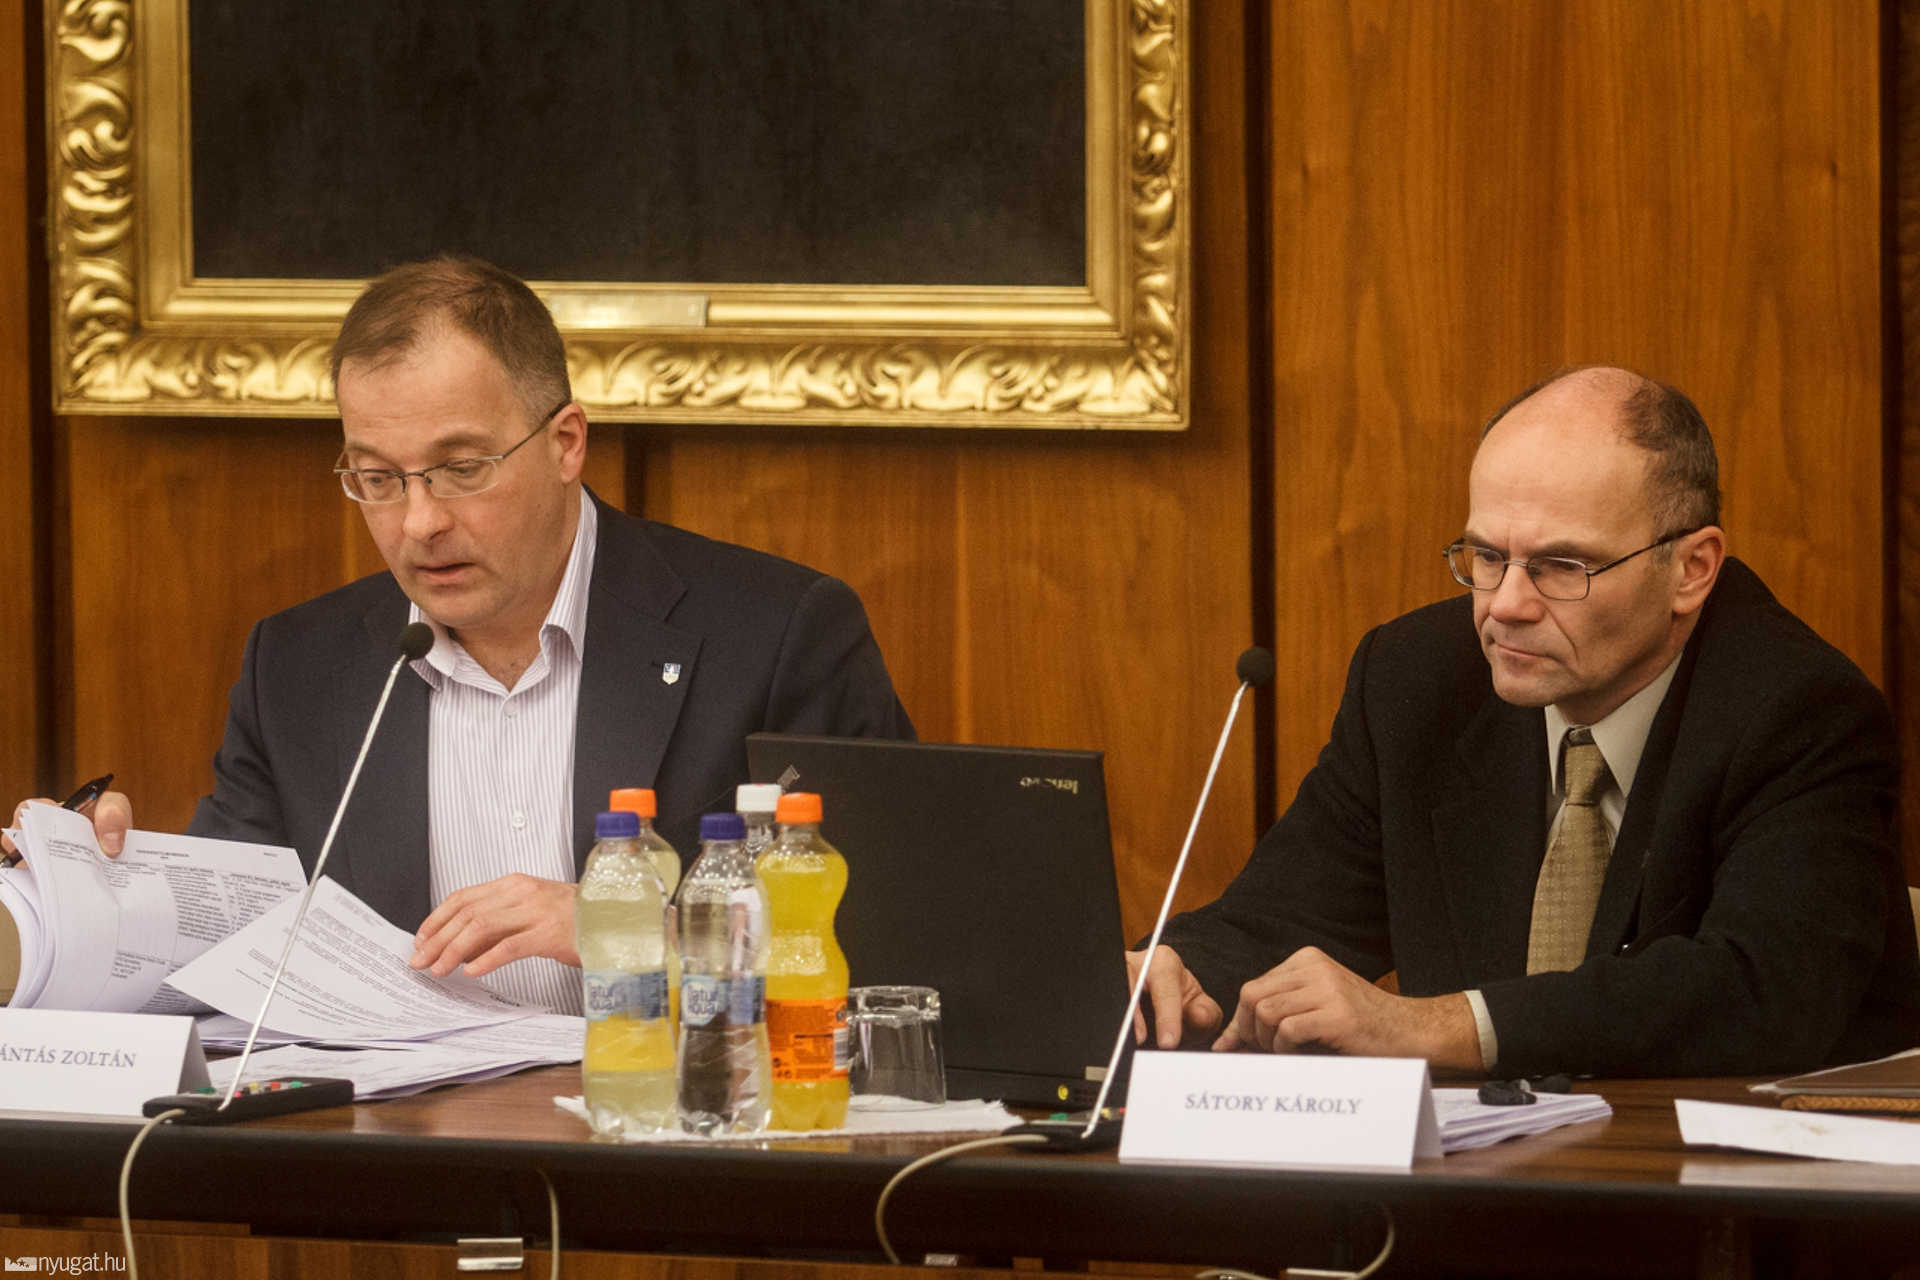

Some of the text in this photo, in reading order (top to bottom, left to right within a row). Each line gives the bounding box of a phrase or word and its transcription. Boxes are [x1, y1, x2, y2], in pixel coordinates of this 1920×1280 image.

[60, 1048, 137, 1068] ZOLTÁN
[1184, 1090, 1363, 1115] SÁTORY KÁROLY
